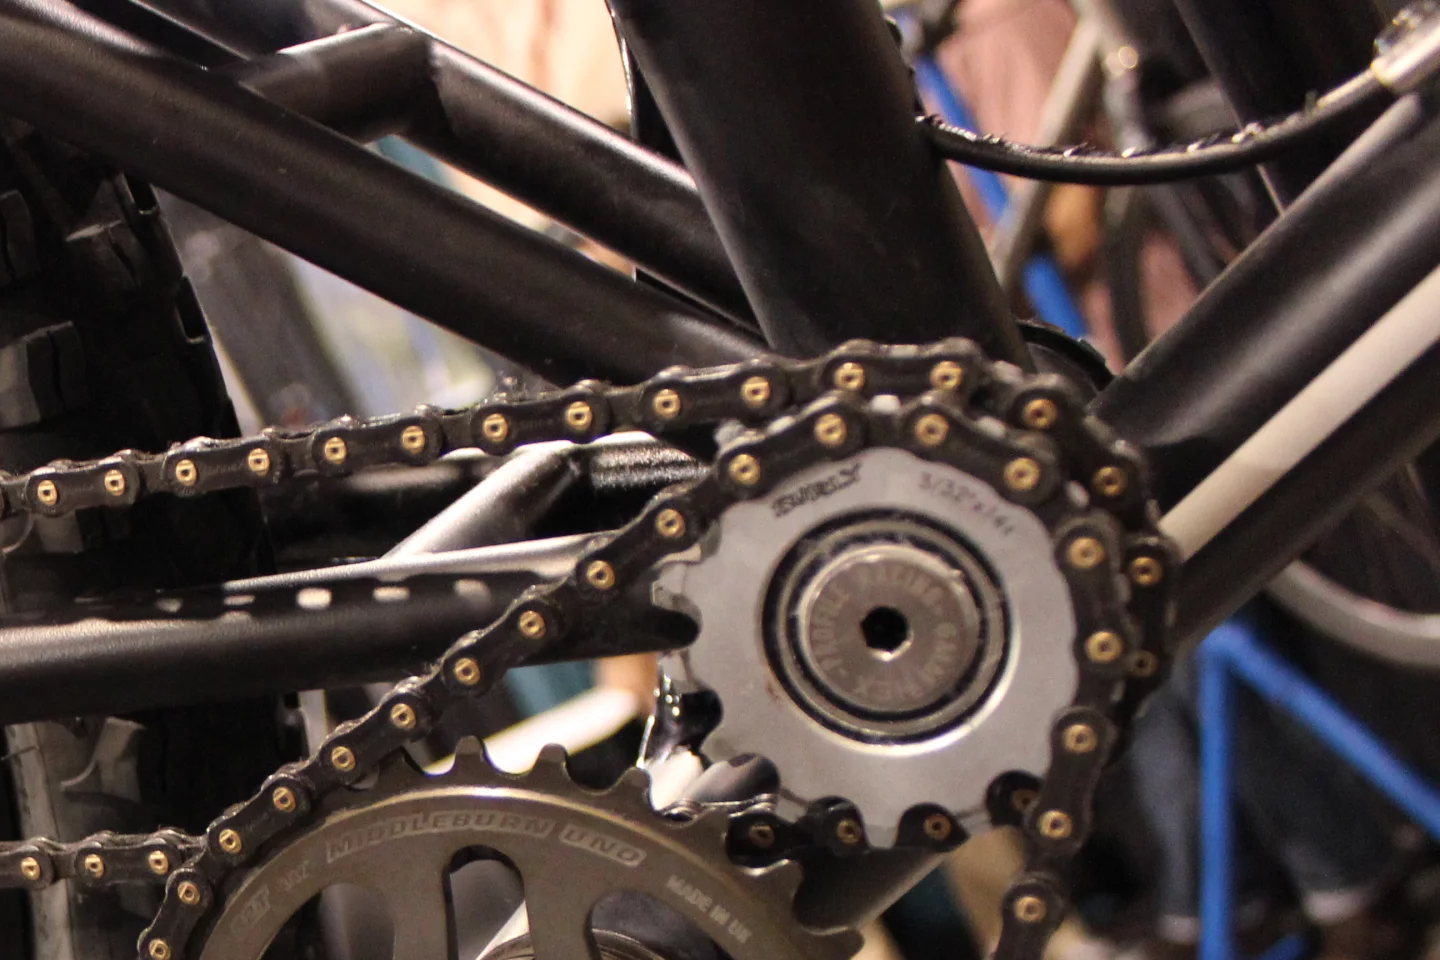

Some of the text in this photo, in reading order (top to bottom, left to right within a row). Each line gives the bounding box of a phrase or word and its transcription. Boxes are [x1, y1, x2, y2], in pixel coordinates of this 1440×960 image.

[327, 810, 647, 867] MIDDLEBURN UNO
[666, 874, 753, 944] MADE IN UK
